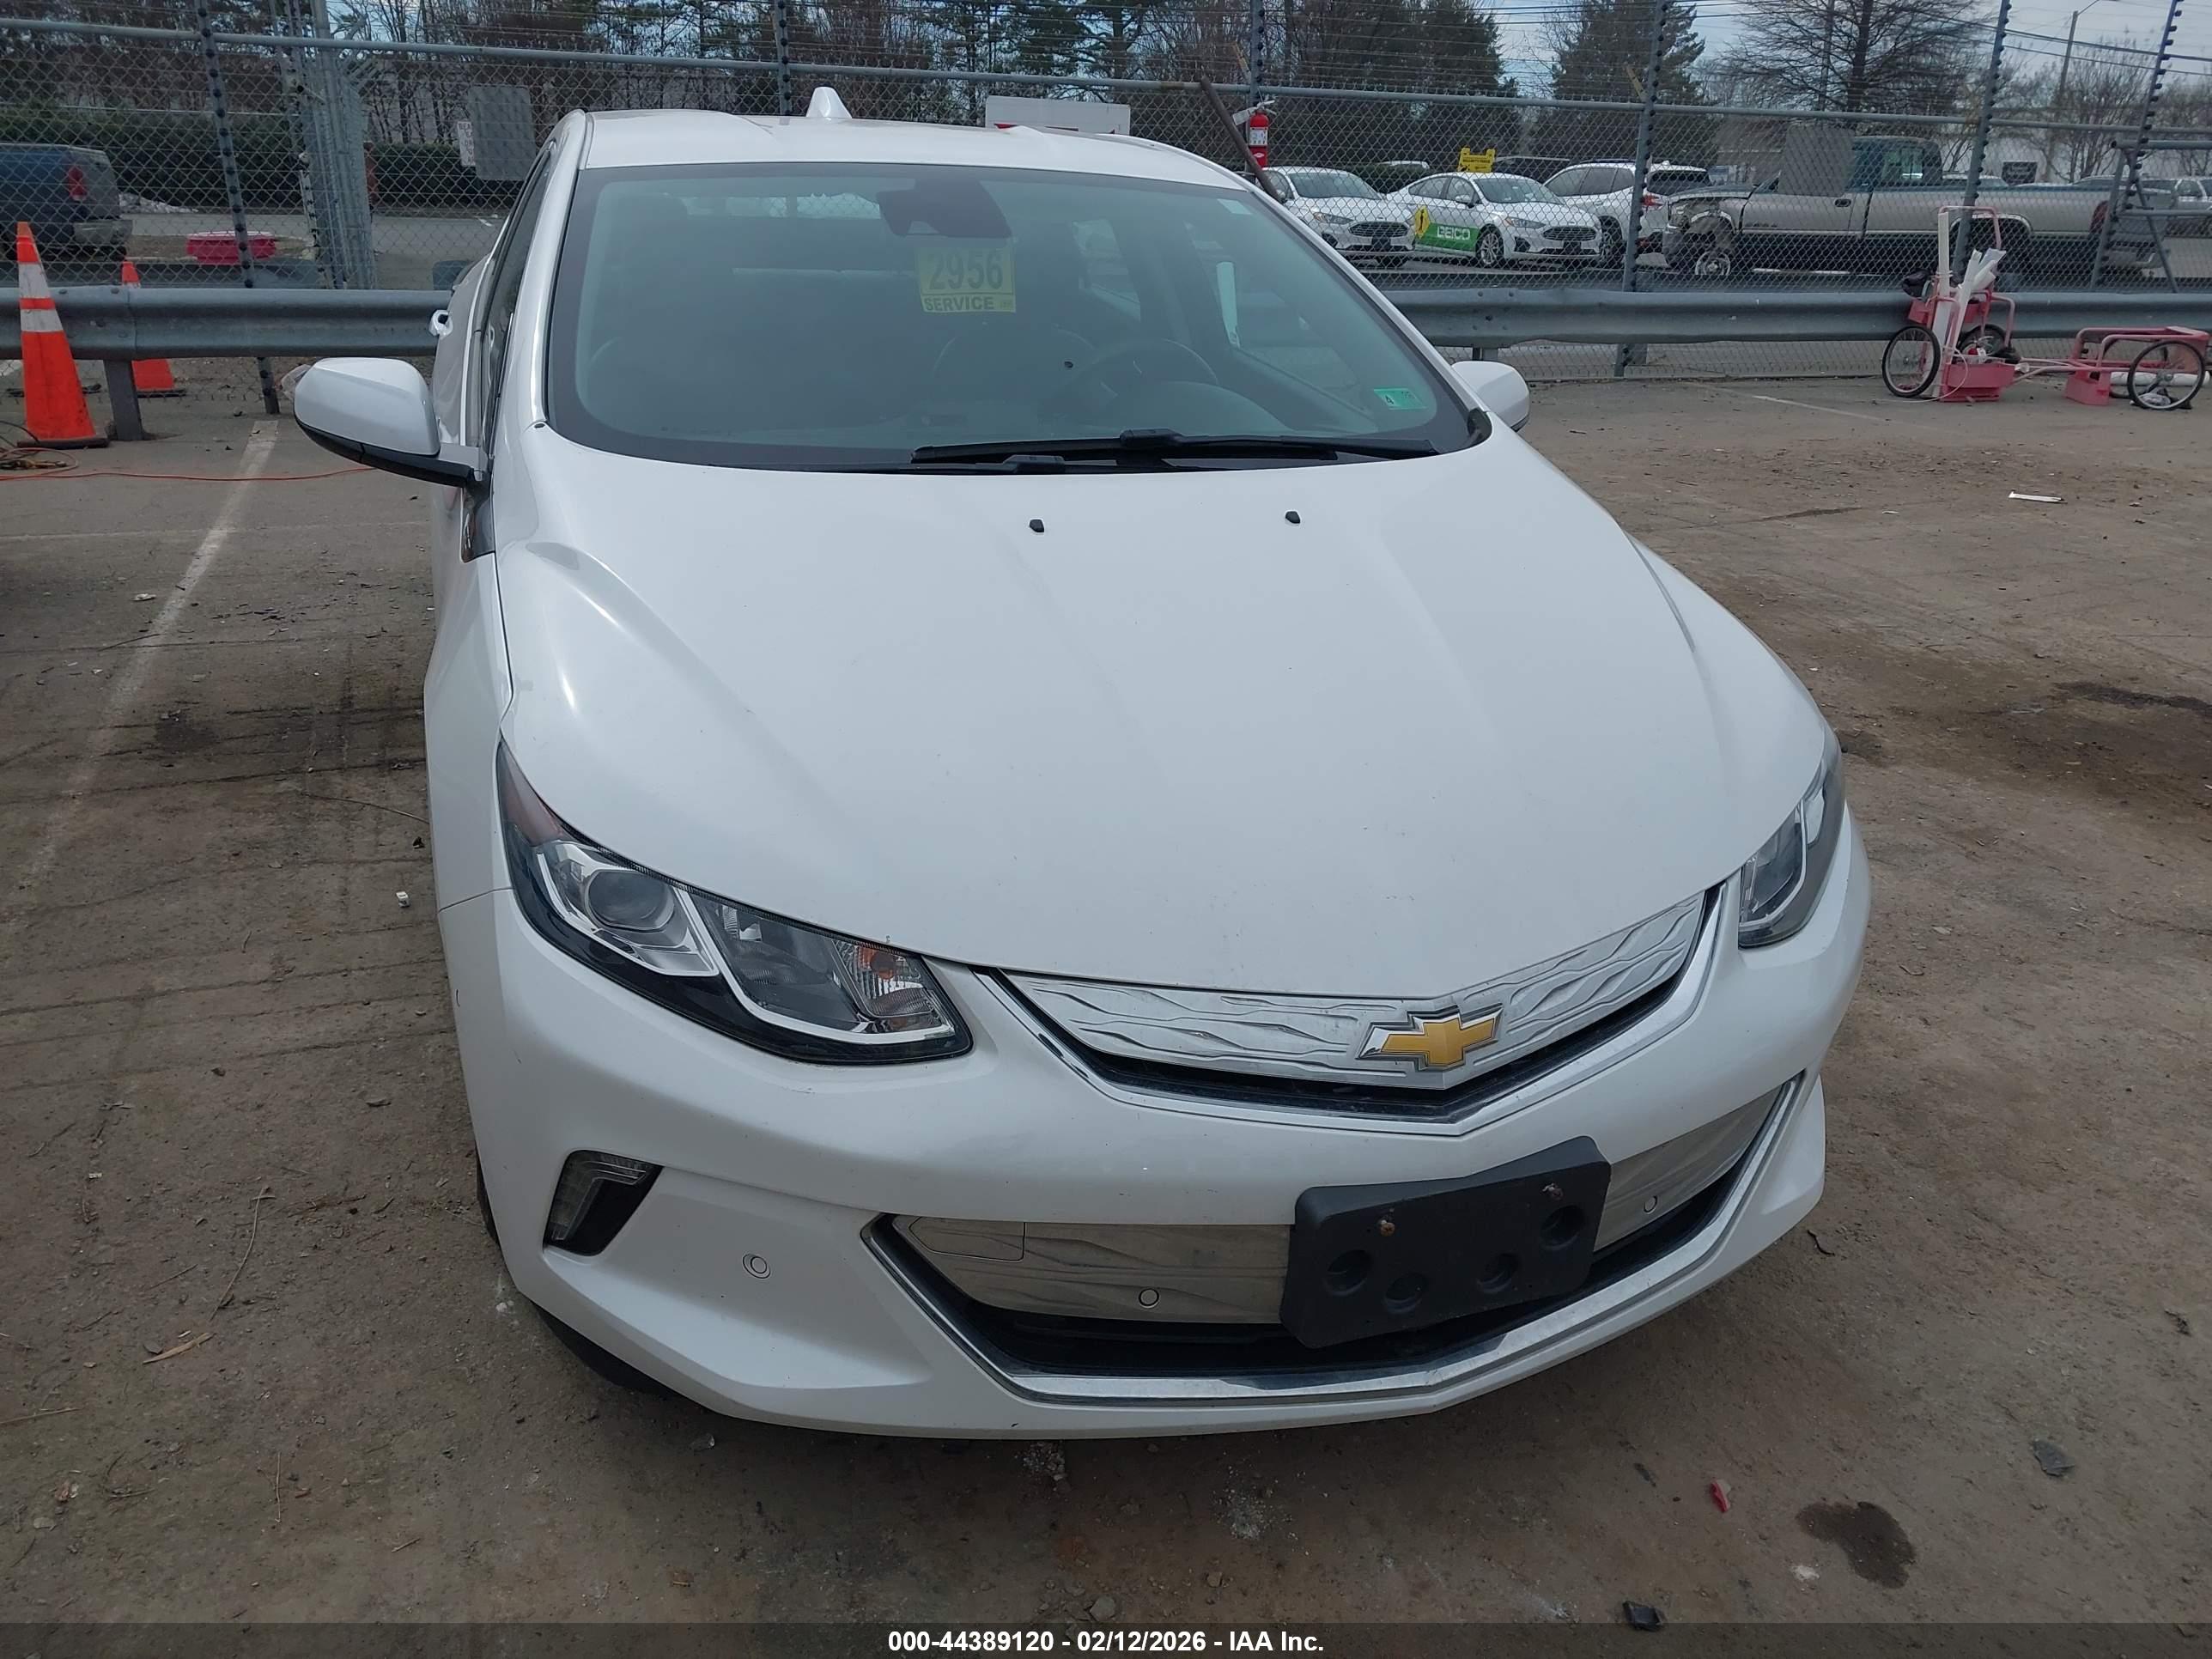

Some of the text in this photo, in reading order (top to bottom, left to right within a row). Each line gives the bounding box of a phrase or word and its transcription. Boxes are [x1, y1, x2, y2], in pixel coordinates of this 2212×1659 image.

[1437, 225, 1471, 240] GEICO
[929, 250, 1004, 290] 2956
[923, 295, 995, 312] SERVICE
